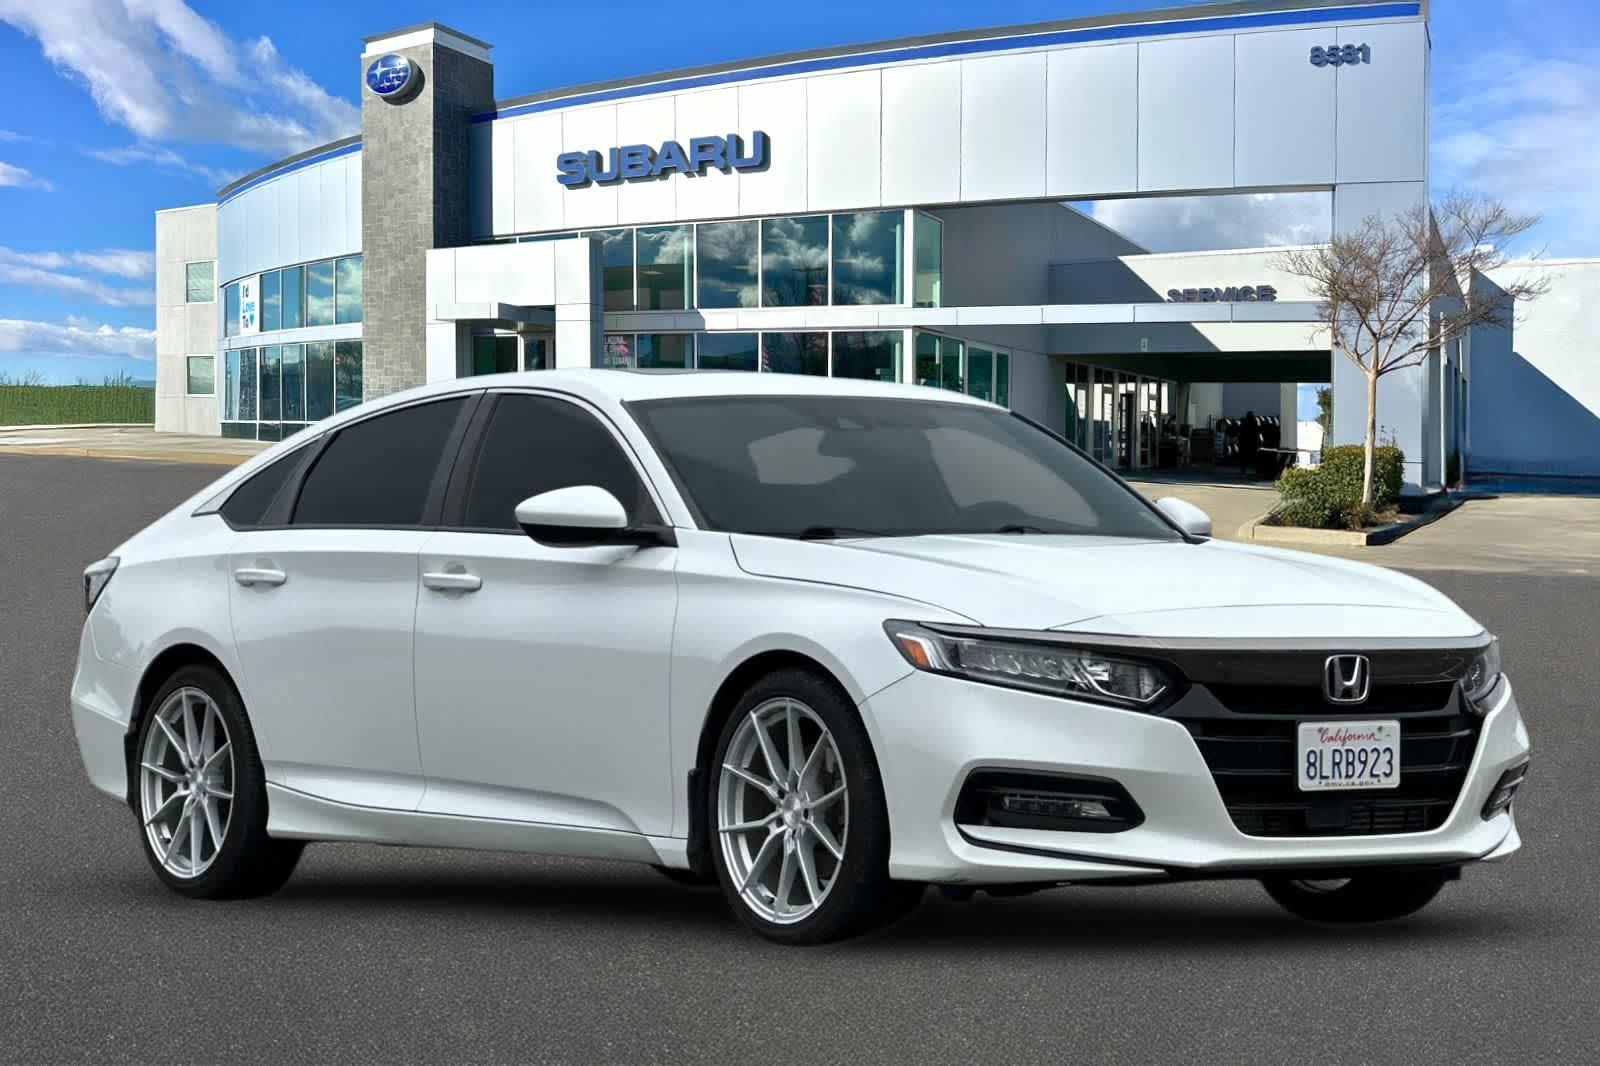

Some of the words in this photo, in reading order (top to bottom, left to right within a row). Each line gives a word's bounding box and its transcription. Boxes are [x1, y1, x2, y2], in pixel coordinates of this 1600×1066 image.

[556, 130, 771, 190] SUBARU
[1167, 285, 1277, 303] SERVICE
[1319, 727, 1379, 746] California
[1306, 747, 1393, 780] 8LRB923
